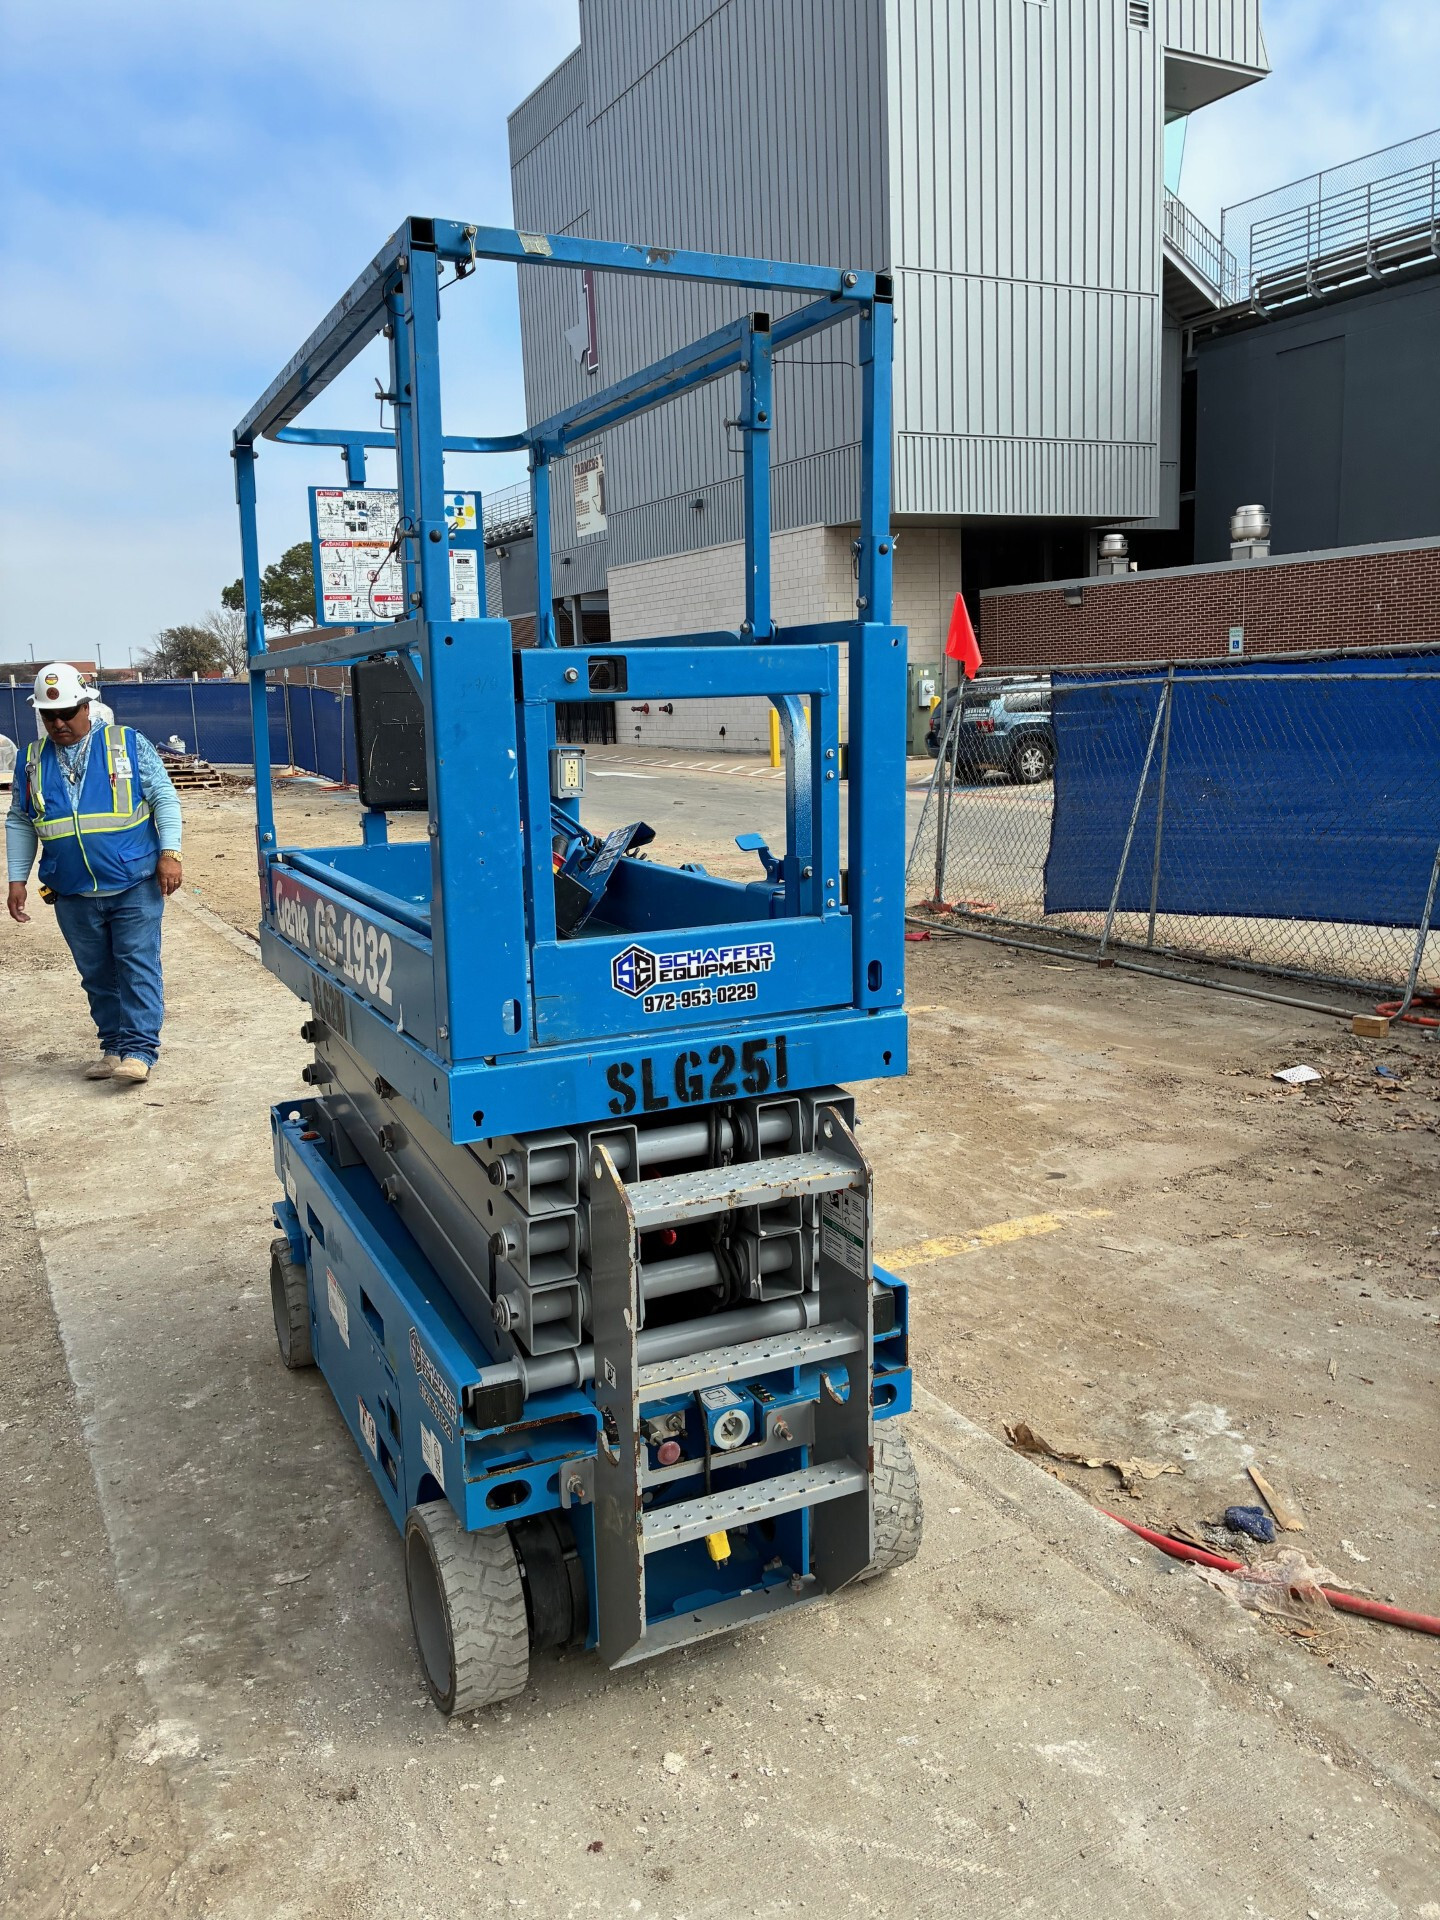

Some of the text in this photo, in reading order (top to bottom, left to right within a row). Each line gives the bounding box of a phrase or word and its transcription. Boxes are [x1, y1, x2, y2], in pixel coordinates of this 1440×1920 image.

[314, 898, 393, 1006] GS-1932
[658, 944, 773, 968] SCHAFFER
[659, 957, 773, 982] EQUIPMENT
[644, 984, 756, 1012] 972-953-0229
